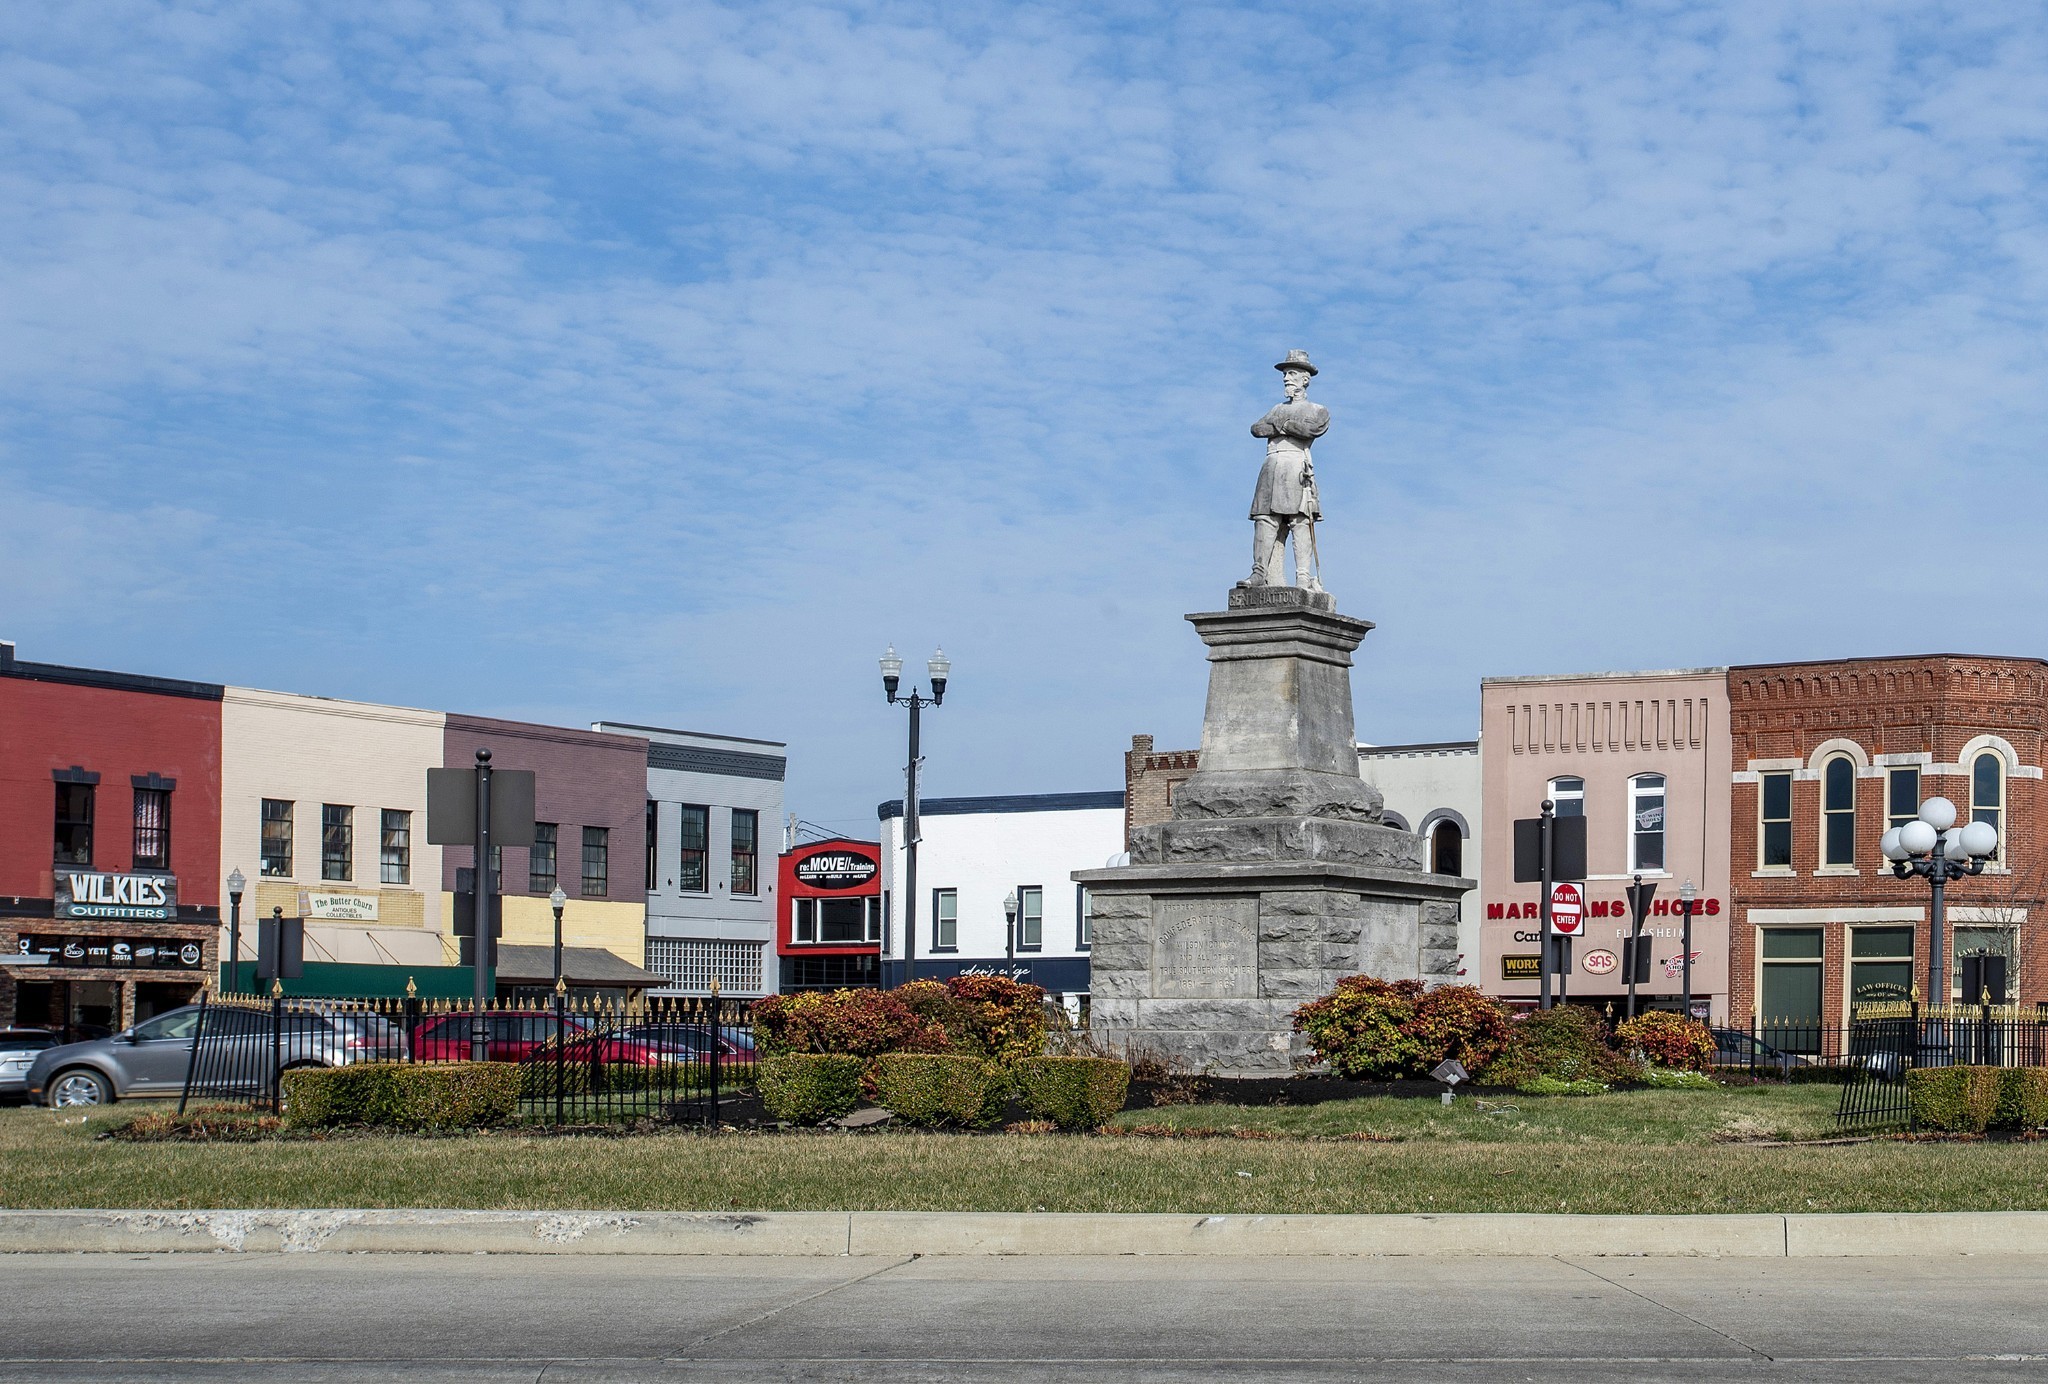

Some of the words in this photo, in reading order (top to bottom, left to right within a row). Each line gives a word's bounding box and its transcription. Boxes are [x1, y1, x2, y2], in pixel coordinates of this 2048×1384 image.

[69, 874, 166, 906] WILKIE'S
[1554, 892, 1564, 901] DO
[1565, 893, 1577, 902] NOT
[315, 899, 328, 908] The
[330, 897, 351, 906] Butter
[353, 898, 373, 911] Churn
[1487, 900, 1626, 920] MARMS
[1645, 898, 1720, 917] HOES
[71, 906, 165, 918] OUTFITTERS
[1556, 915, 1576, 925] ENTER
[88, 947, 108, 955] YETI
[1505, 959, 1539, 970] WORX
[1588, 955, 1613, 968] SAS
[1856, 983, 1873, 993] LAW
[1874, 982, 1907, 993] OFFICES
[1693, 1004, 1709, 1015] SAS
